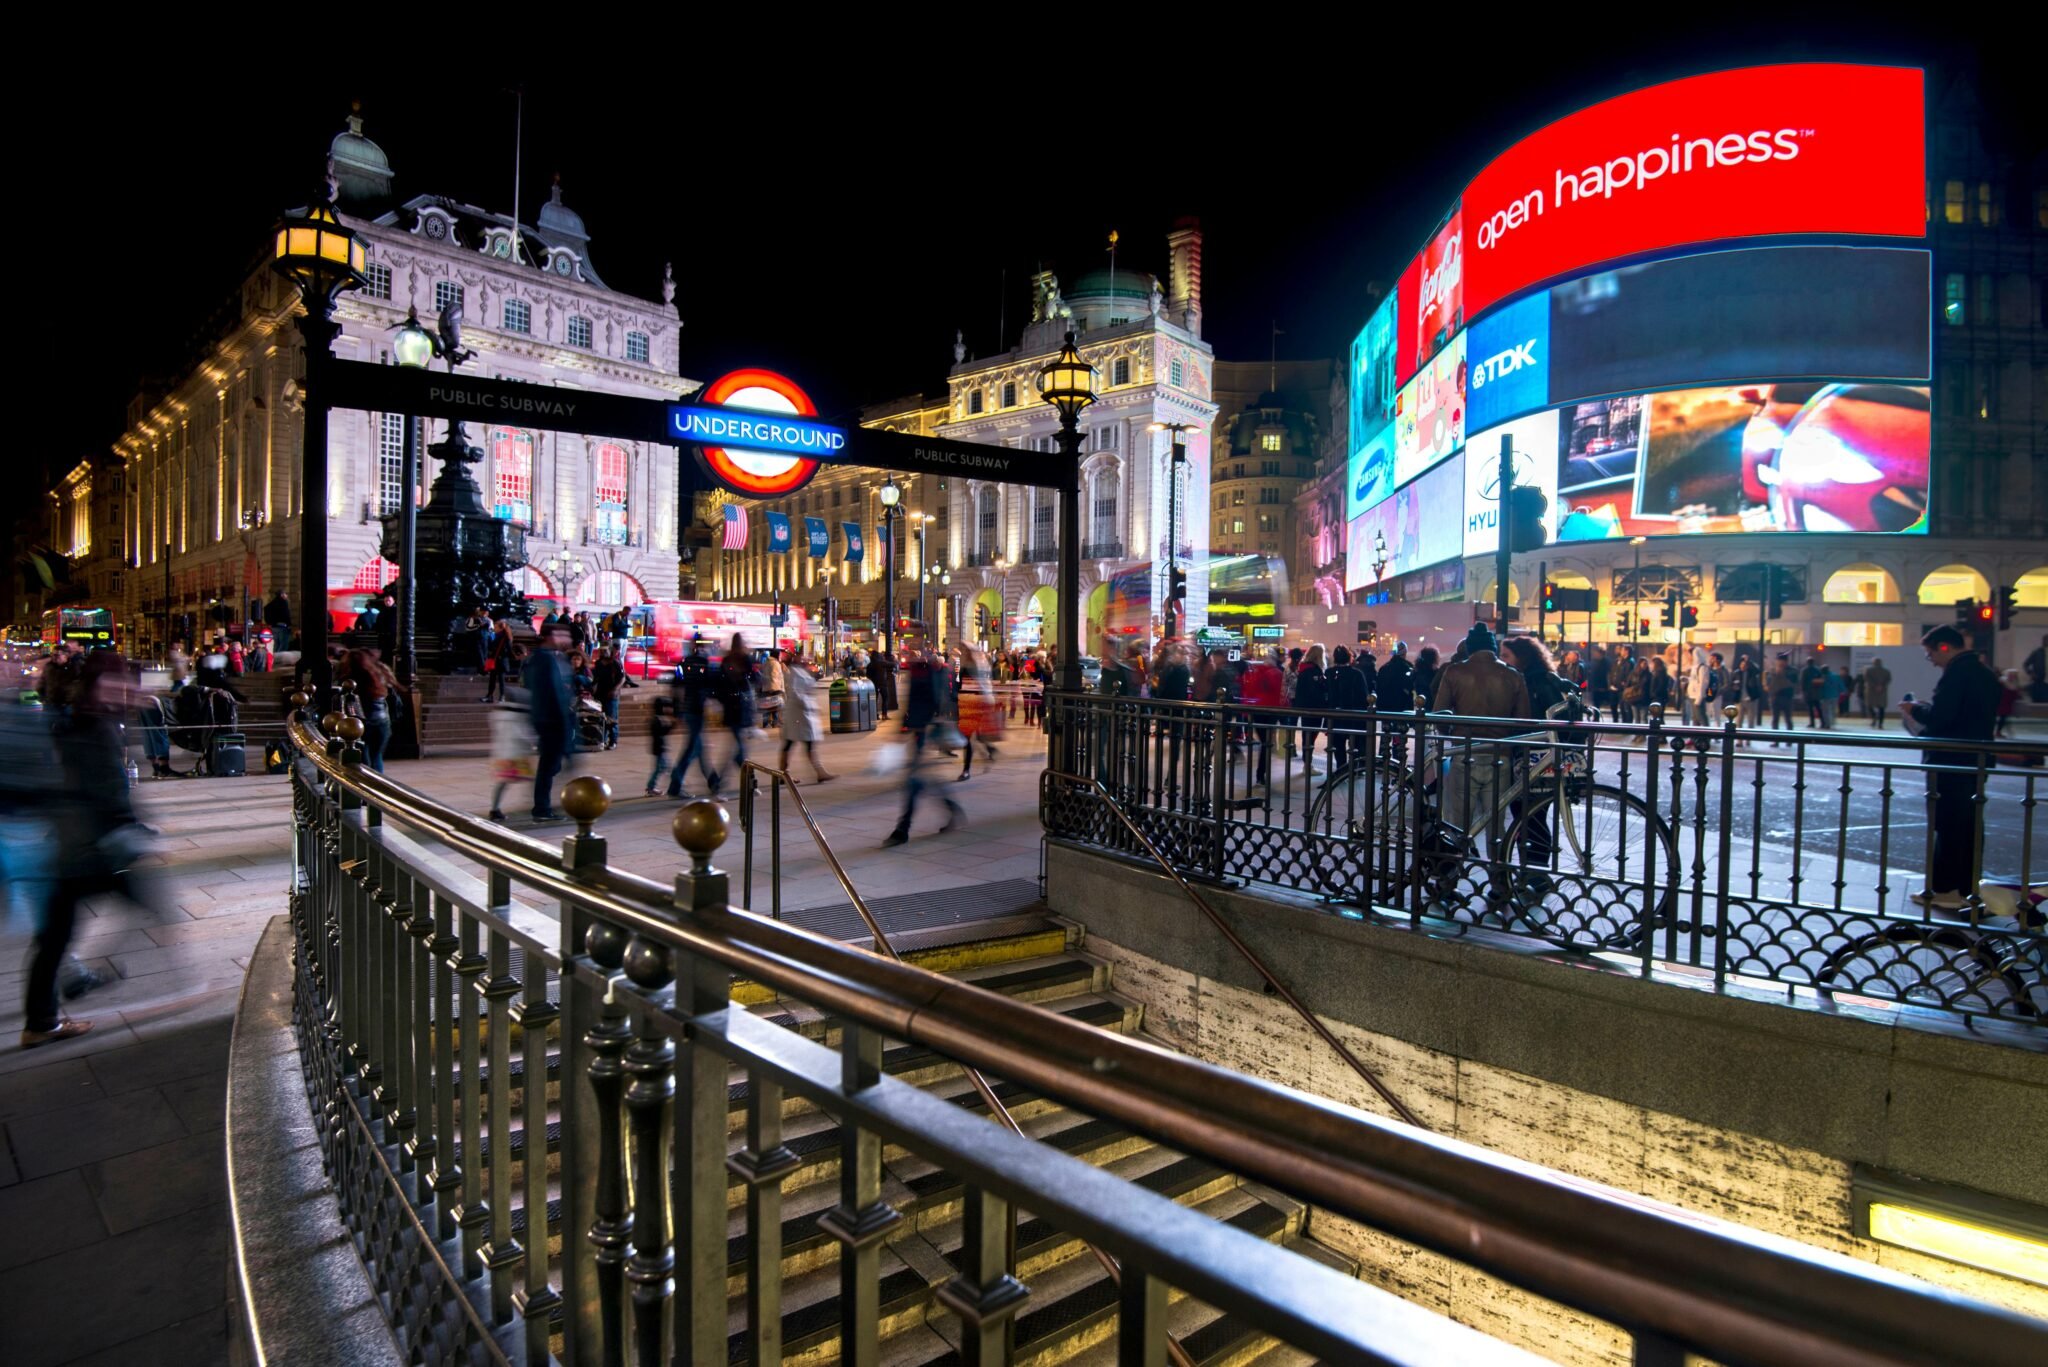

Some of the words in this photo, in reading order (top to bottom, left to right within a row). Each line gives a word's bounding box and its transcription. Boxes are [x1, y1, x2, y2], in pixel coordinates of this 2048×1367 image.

[1477, 189, 1544, 249] open
[1554, 128, 1800, 208] happiness
[1484, 338, 1537, 382] TDK
[429, 387, 495, 407] PUBLIC
[499, 395, 577, 417] SUBWAY
[674, 412, 846, 451] UNDERGROUND
[914, 448, 957, 464] PUBLIC
[960, 453, 1010, 470] SUBWAY
[1358, 460, 1383, 490] SAMSUNG
[1468, 509, 1498, 533] HYU
